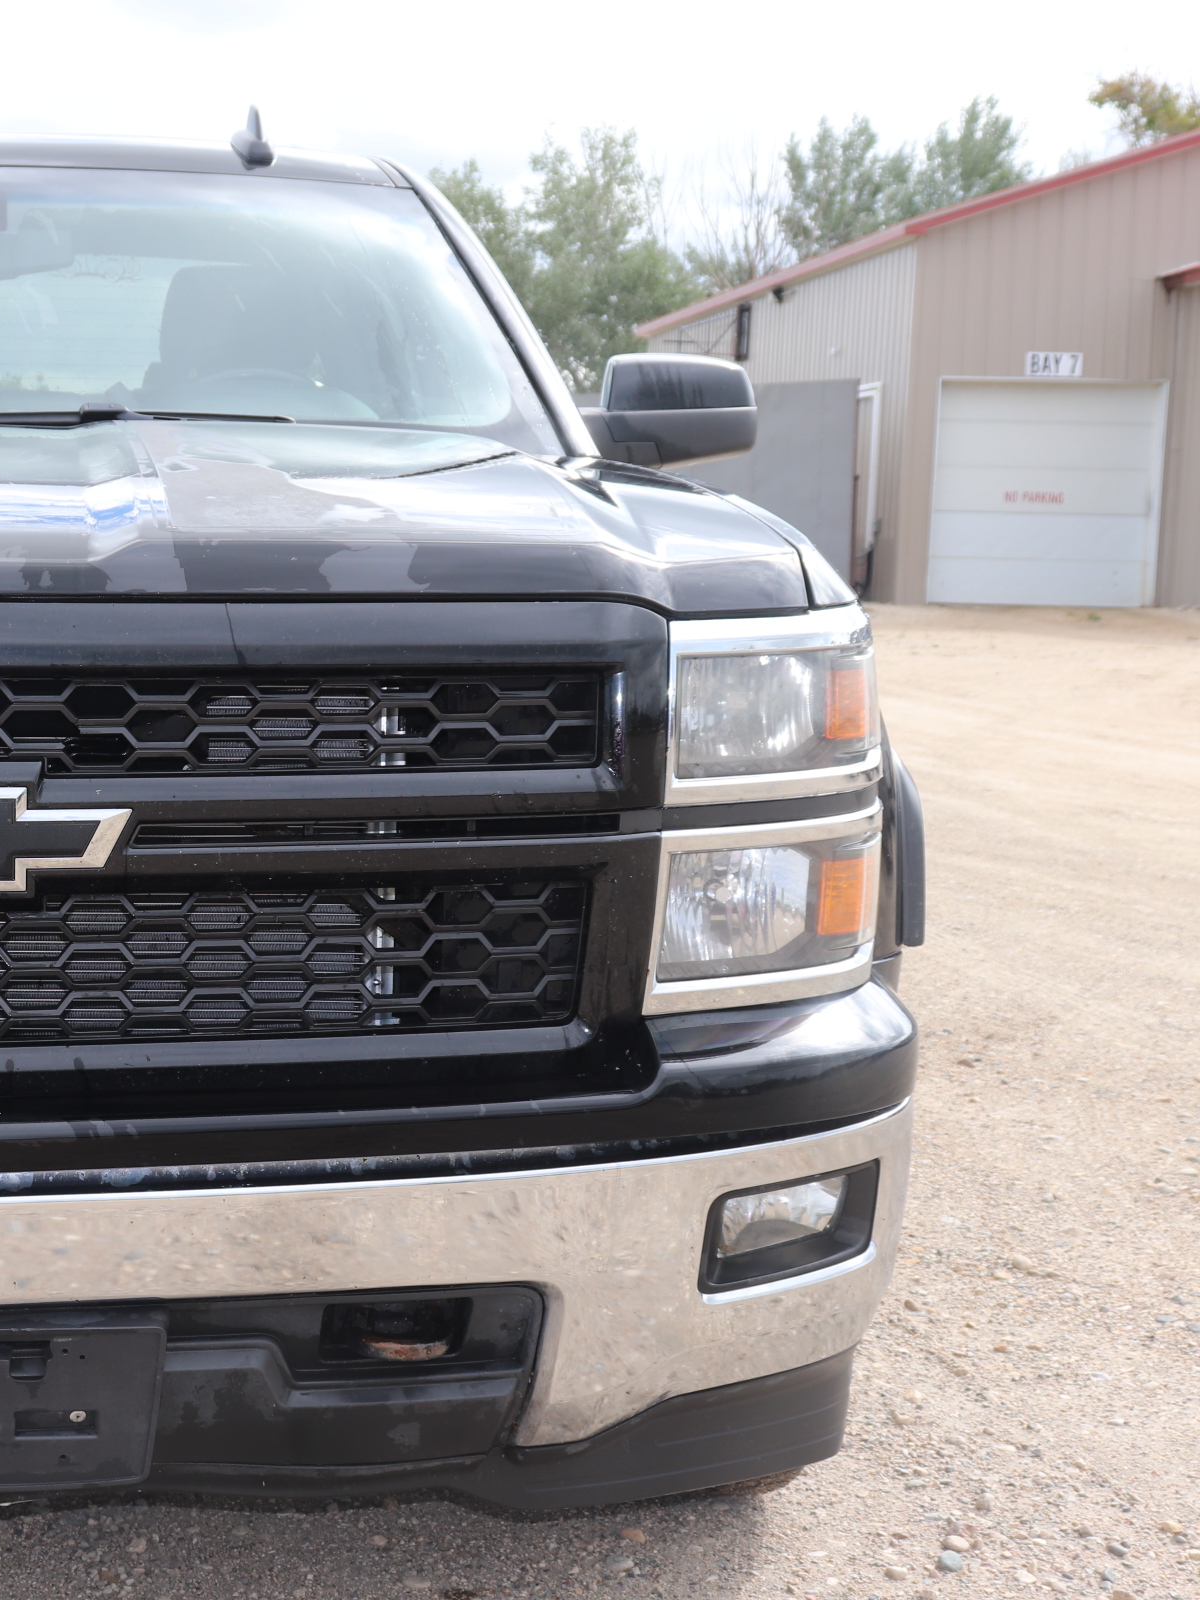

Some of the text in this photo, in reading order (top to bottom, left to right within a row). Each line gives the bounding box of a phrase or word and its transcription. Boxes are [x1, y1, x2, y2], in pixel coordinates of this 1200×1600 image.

[1030, 353, 1080, 374] BAY 7
[1005, 490, 1065, 504] NO PARKING
